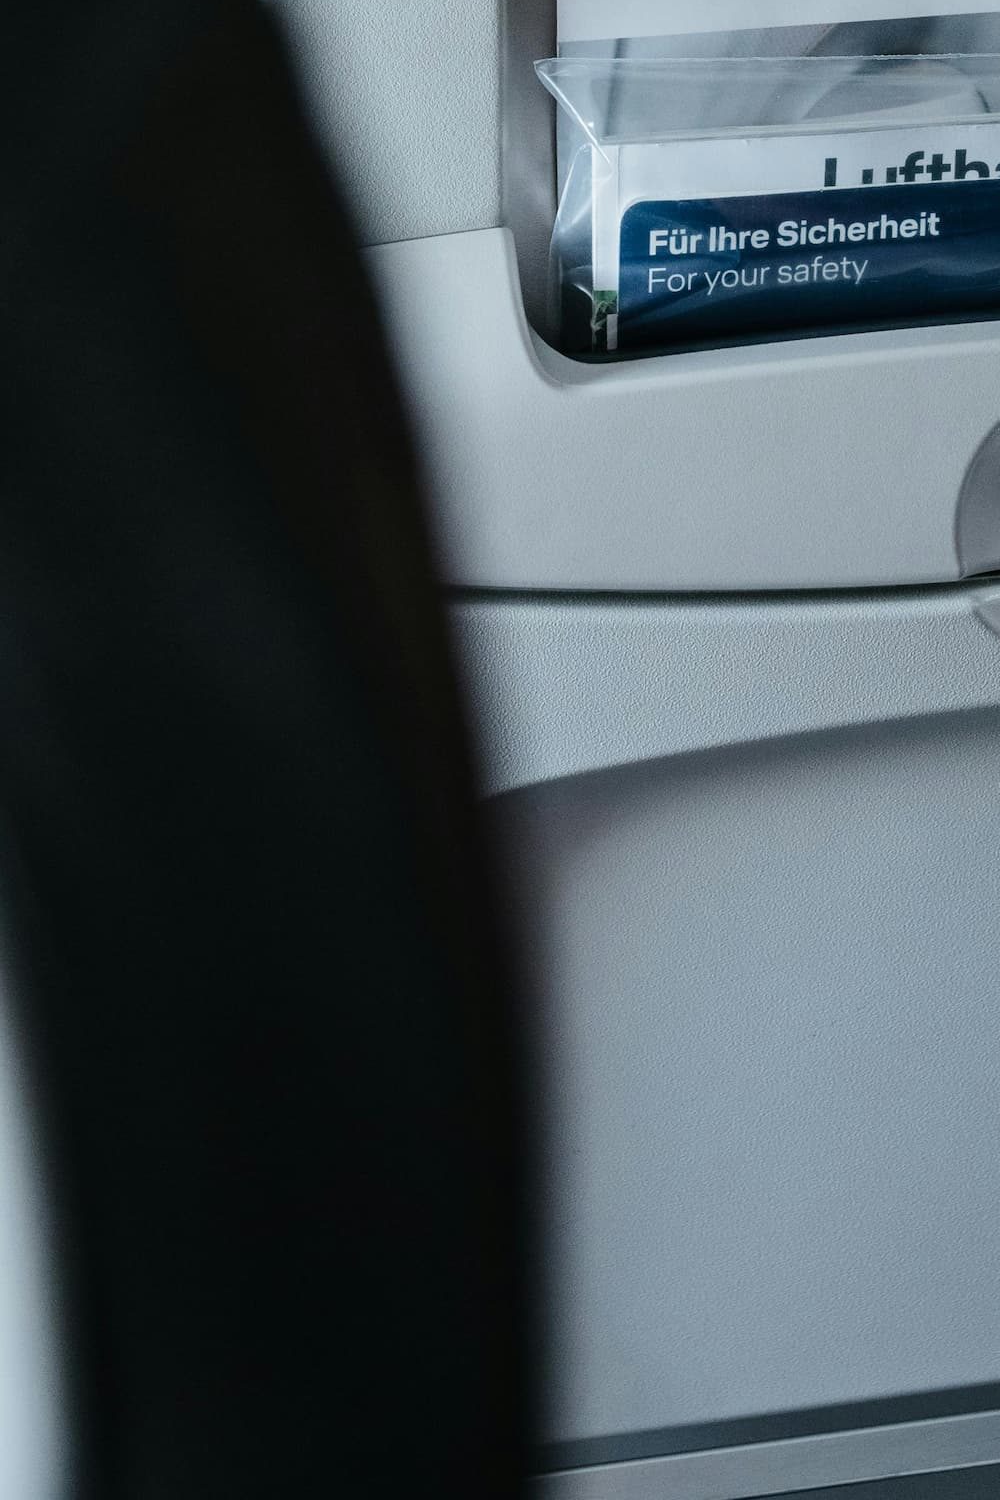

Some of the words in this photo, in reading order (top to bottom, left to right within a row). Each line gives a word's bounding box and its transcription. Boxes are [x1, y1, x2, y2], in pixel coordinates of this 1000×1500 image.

[649, 228, 702, 256] Für
[709, 226, 770, 252] Ihre
[777, 211, 940, 247] Sicherheit
[648, 266, 698, 294] For
[704, 264, 770, 296] your
[777, 255, 869, 284] safety
